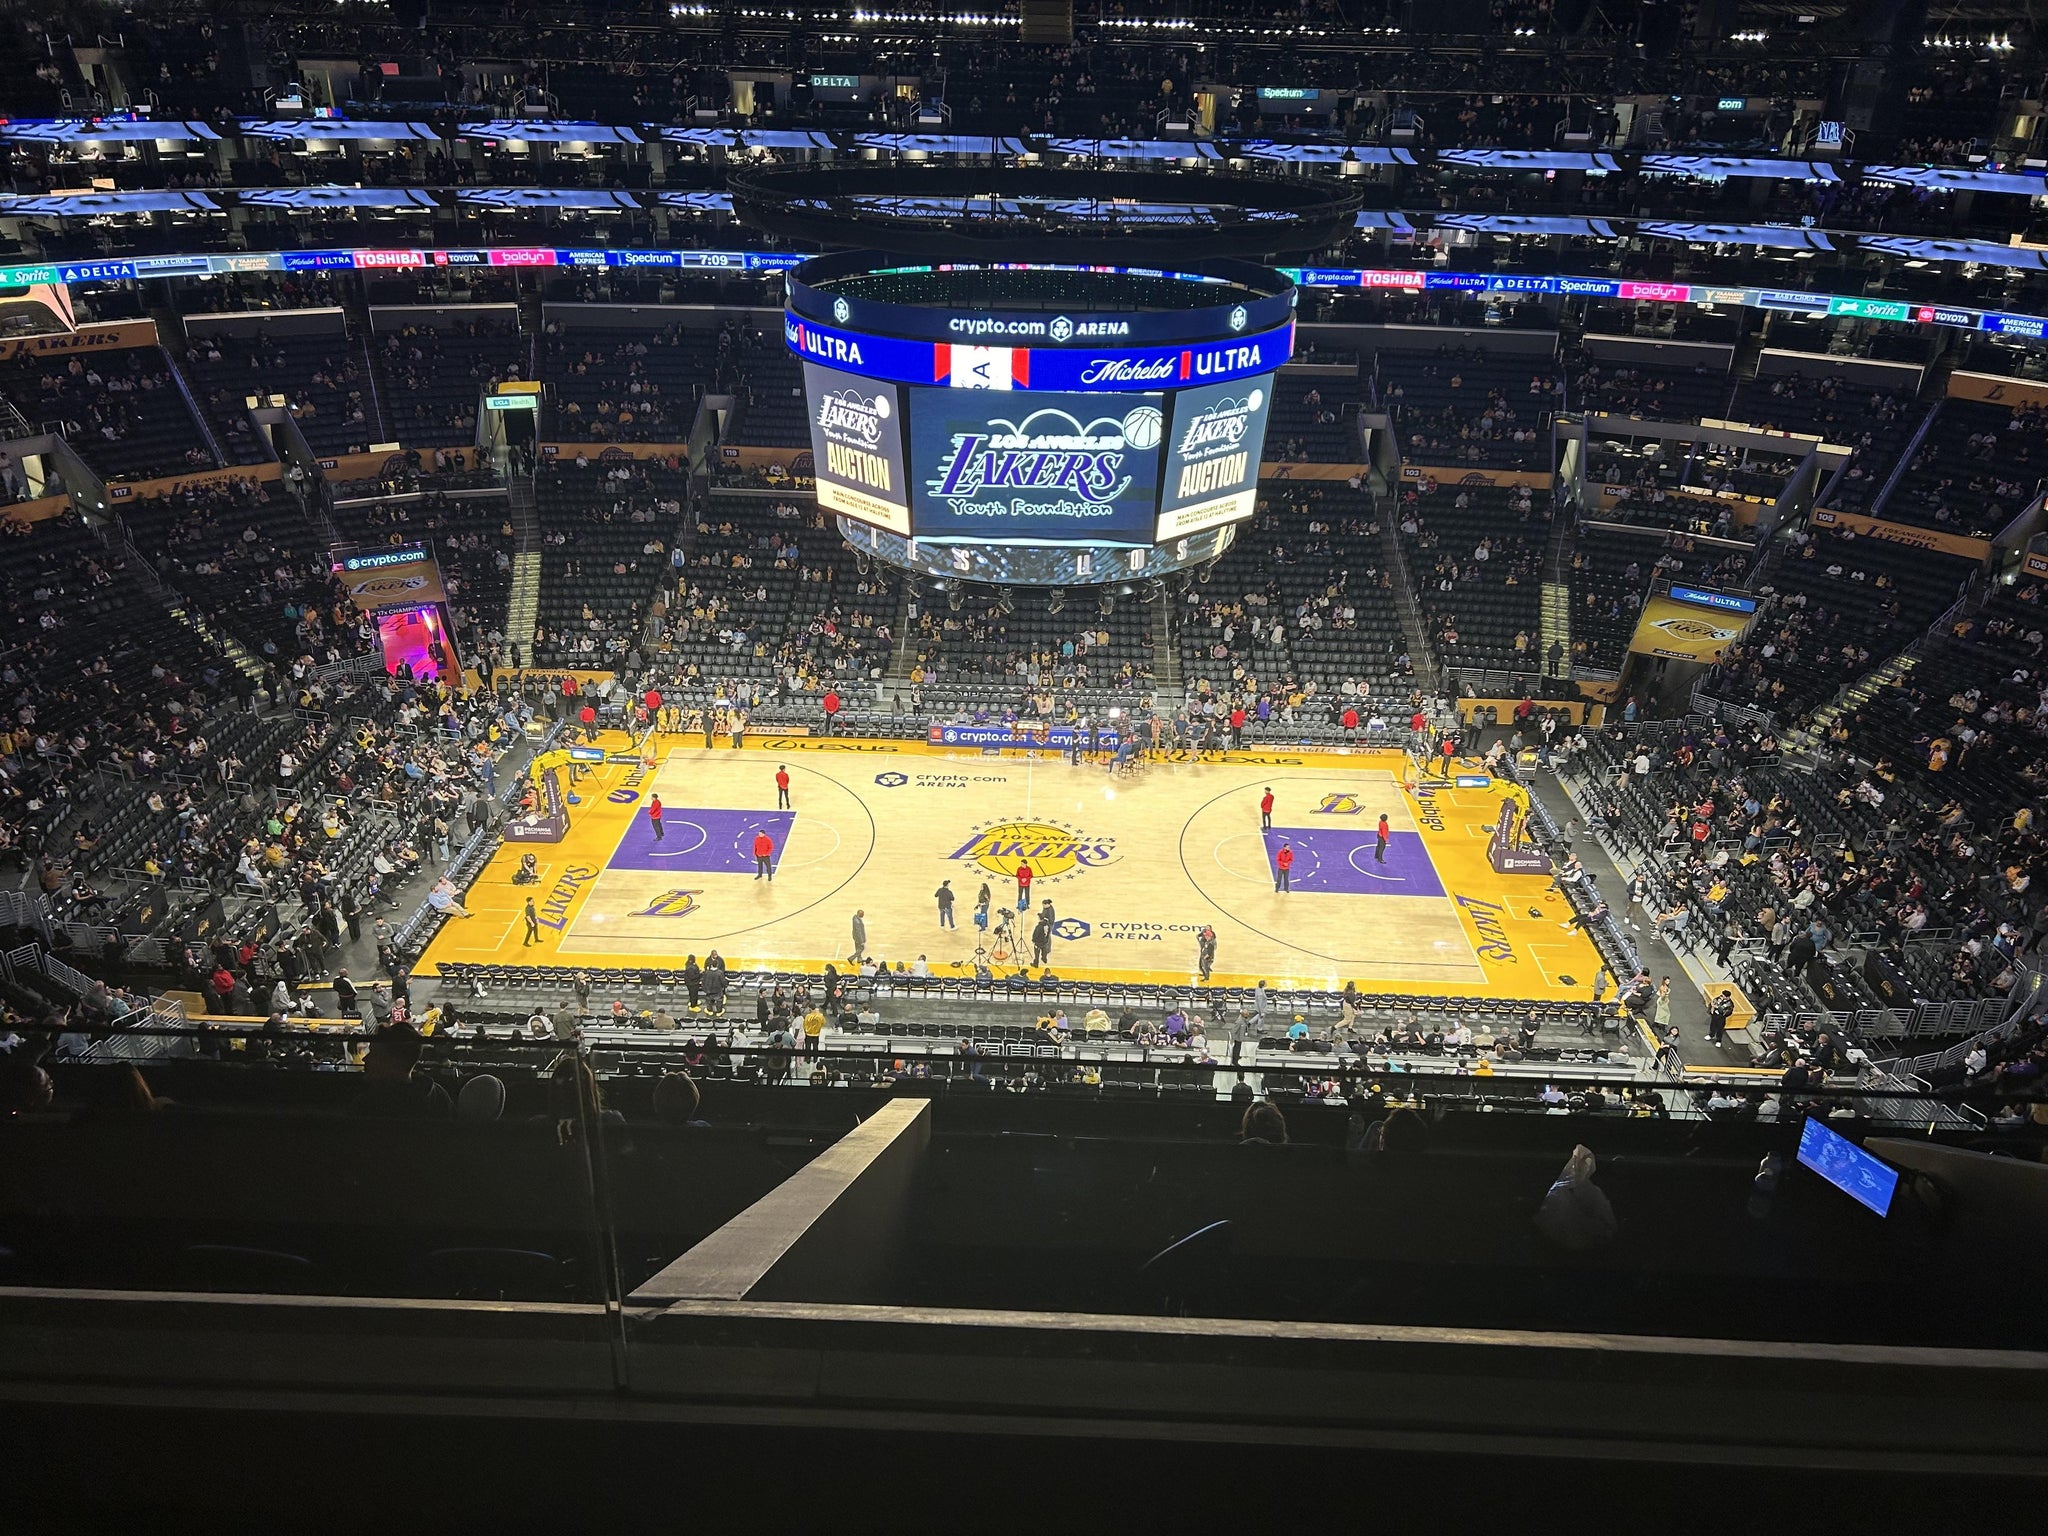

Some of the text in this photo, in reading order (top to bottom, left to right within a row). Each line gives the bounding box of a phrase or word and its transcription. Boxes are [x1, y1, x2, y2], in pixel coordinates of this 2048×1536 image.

[813, 77, 851, 86] DELTA
[1264, 87, 1304, 98] Spectrum
[321, 255, 351, 265] ULTRA
[356, 252, 421, 265] TOSHIBA
[449, 254, 480, 262] TOYOTA
[501, 252, 545, 263] boldyn
[625, 252, 673, 265] Spectrum
[699, 254, 729, 266] 7:09
[761, 257, 800, 267] crypto.com
[14, 269, 50, 283] Sprite
[81, 264, 131, 278] DELTA
[1317, 273, 1356, 283] crypto.com
[1365, 274, 1422, 286] TOSHIBA
[1459, 278, 1486, 286] ULTRA
[1507, 280, 1549, 289] DELTA
[1560, 280, 1610, 294] Spectrum
[1632, 284, 1677, 298] boldyn
[1862, 303, 1899, 316] Sprite
[1935, 313, 1969, 324] TOYOTA
[1998, 317, 2043, 328] AMERICAN
[949, 316, 1129, 336] crypto.com ARENA
[2003, 324, 2043, 336] EXPRESS
[16, 331, 120, 352] LAKERS
[806, 330, 863, 365] ULTRA
[1081, 346, 1262, 383] Michelob ULTRA
[817, 395, 882, 443] LAKERS
[1177, 415, 1248, 454] LAKERS
[988, 434, 1029, 449] LOS
[826, 441, 891, 492] AUCTION
[926, 433, 1132, 503] LAKERS
[1177, 451, 1248, 499] AUCTION
[114, 488, 128, 497] 117
[948, 498, 1113, 518] Youth Foundation
[1818, 513, 1834, 522] 105
[361, 551, 424, 568] crypto.com
[2030, 559, 2047, 571] 106
[1715, 598, 1741, 607] ULTRA
[800, 743, 898, 752] LEXUS
[1203, 756, 1303, 766] LEXUS
[916, 774, 1007, 784] crypto.com
[1418, 800, 1445, 831] bibigo
[1034, 835, 1117, 843] ANGELES
[938, 834, 1124, 867] LAKERS
[536, 863, 599, 931] LAKERS
[1453, 892, 1517, 966] LAKERS
[1102, 932, 1162, 940] ARENA
